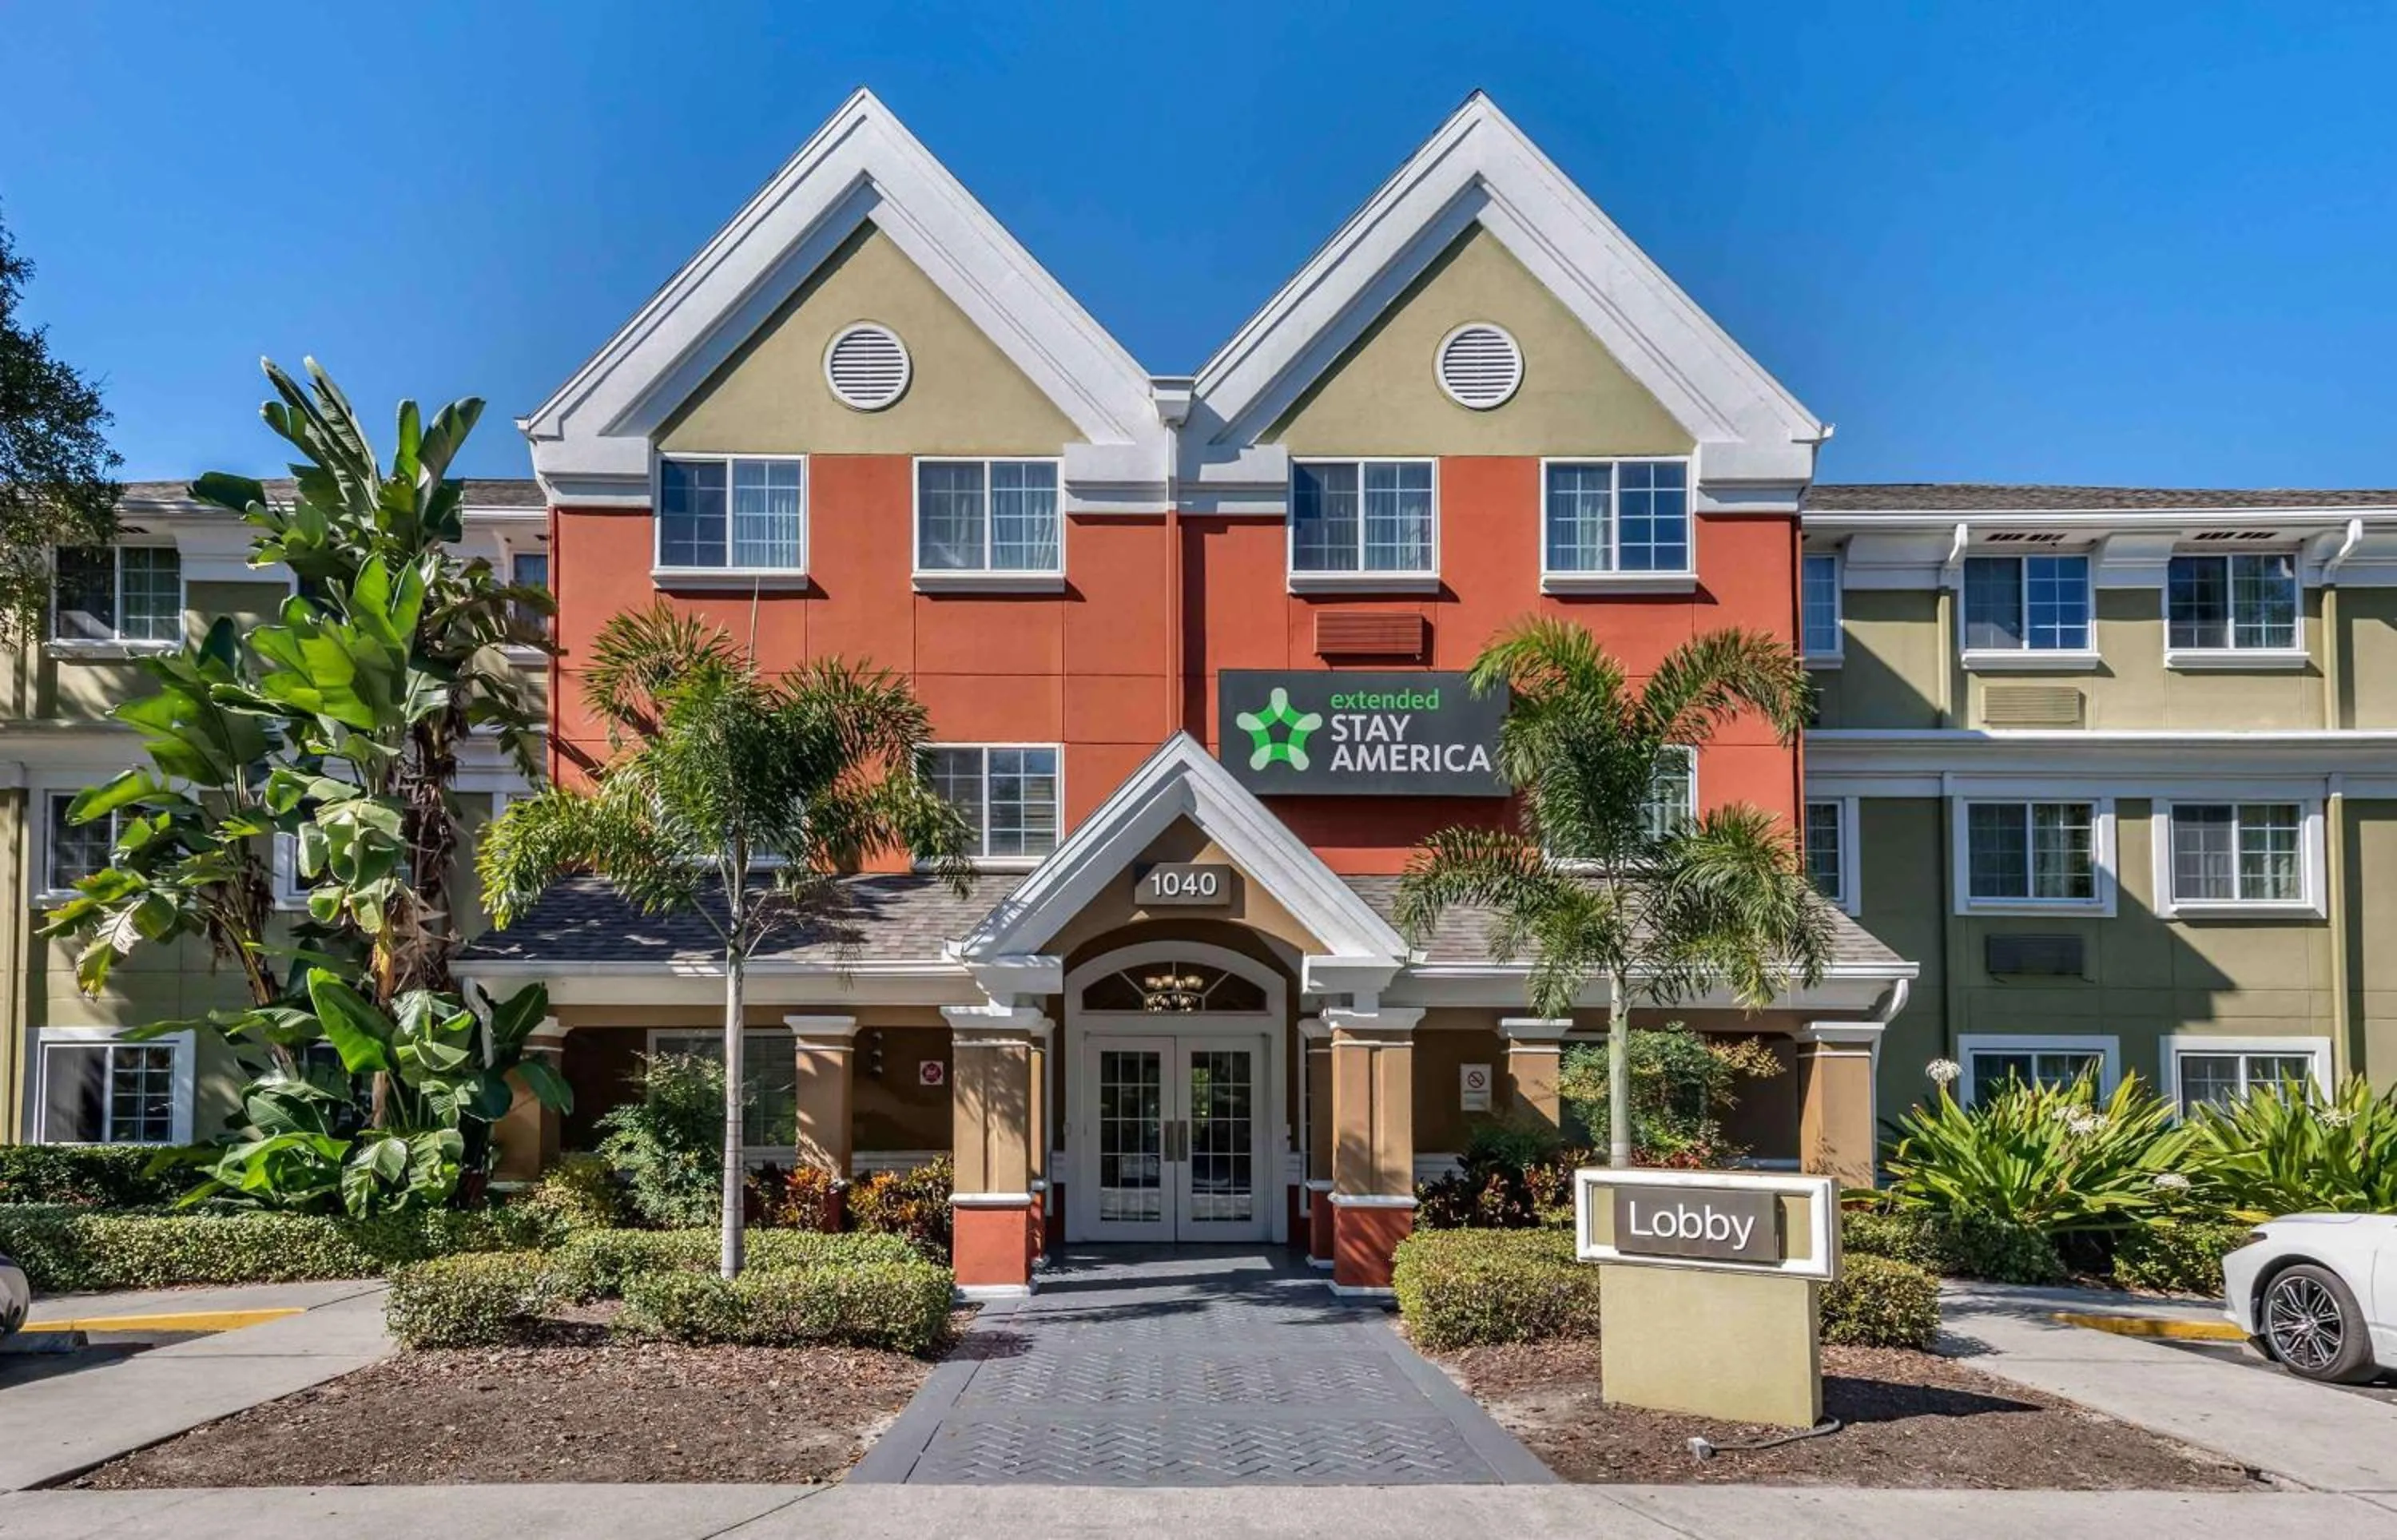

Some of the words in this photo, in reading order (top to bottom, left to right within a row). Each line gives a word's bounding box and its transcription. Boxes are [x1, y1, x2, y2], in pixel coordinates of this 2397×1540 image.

[1330, 688, 1439, 710] extended
[1330, 714, 1411, 742] STAY
[1330, 744, 1492, 772] AMERICA
[1151, 871, 1217, 895] 1040
[1628, 1200, 1755, 1250] Lobby
